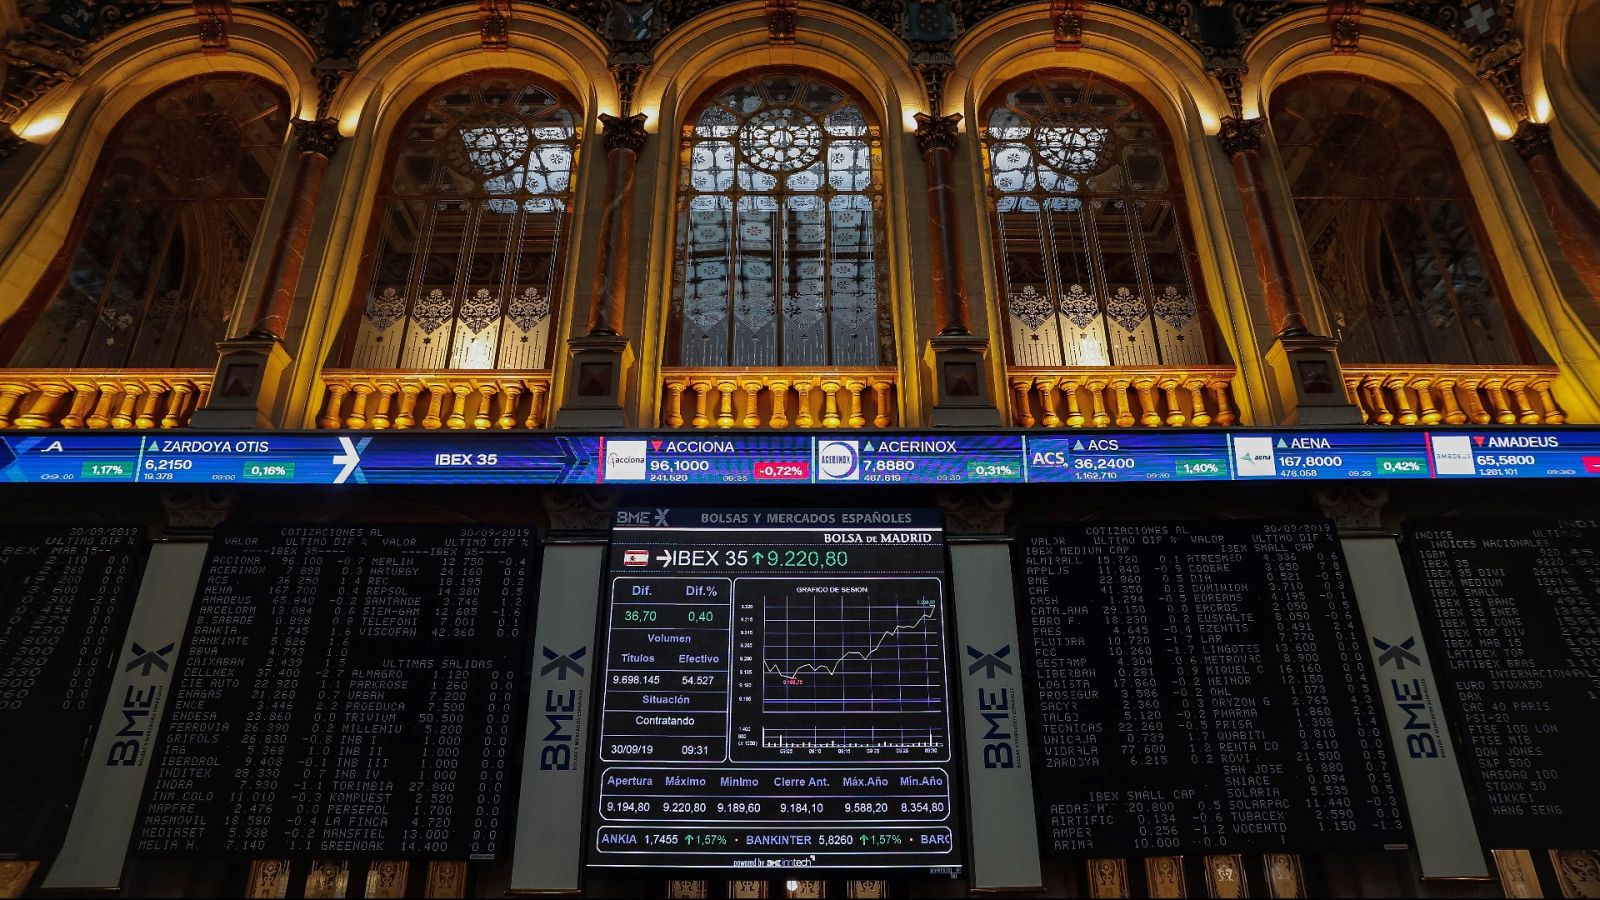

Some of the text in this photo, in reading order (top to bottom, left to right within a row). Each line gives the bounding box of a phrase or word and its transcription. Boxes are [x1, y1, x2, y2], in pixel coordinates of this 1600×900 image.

[162, 441, 269, 452] ZARDOYA OTIS
[666, 441, 735, 452] ACCIONA
[878, 441, 957, 452] ACERINOX
[1088, 440, 1119, 451] ACS
[1290, 438, 1331, 449] AENA
[1488, 436, 1559, 448] AMADEUS
[435, 454, 498, 466] IBEX 35
[615, 456, 645, 464] acciona
[821, 456, 851, 464] ACERINOX
[1032, 453, 1065, 465] ACS
[1074, 458, 1135, 470] 36,2400
[1278, 456, 1342, 468] 167,8000
[1476, 455, 1536, 466] 65,5800
[92, 465, 123, 475] 1,17%
[145, 460, 192, 471] 6,2150
[650, 460, 709, 472] 96,1000
[863, 460, 914, 472] 7,8880
[1184, 464, 1218, 474] 1,40%
[1384, 462, 1420, 472] 0,42%
[251, 466, 285, 476] 0,16%
[759, 466, 803, 477] -0,72%
[976, 466, 1012, 476] 0,31%
[616, 512, 650, 524] BME
[701, 512, 912, 524] BOLSAS Y MERCADOS ESPAÑOLES
[281, 528, 530, 537] COTIZACIONES AL 30/09/2019
[1086, 524, 1330, 535] COTIZACIONES 30/09/2019
[225, 537, 514, 546] VALOR ULTIMO DIF VALOR ULTIMO DIF
[824, 533, 863, 544] BOLSA
[880, 533, 932, 544] MADRID
[1060, 546, 1130, 555] MEDIUM CAP
[212, 556, 260, 565] ACCIONA
[372, 558, 414, 566] MERLIN
[672, 550, 849, 570] IBEX 35 9.220,80
[370, 568, 483, 576] NATURGY 24.160
[1028, 576, 1141, 585] BME 22.860
[205, 586, 232, 595] AENA
[366, 587, 480, 596] REPSOL 14.380
[632, 585, 718, 597] Dif. Dif.%
[1192, 584, 1248, 592] DOMINION
[200, 606, 257, 615] ARCELORM
[363, 608, 420, 616] SIEM-GAM
[362, 618, 418, 626] TELEFONI
[624, 610, 714, 624] 36,70 0,40
[194, 626, 238, 634] BANKIA
[360, 628, 475, 637] VISCOFAN 42.360
[192, 636, 249, 645] BANKINTE
[648, 634, 692, 644] Volumen
[186, 658, 244, 666] CAIXABAN
[621, 653, 720, 664] Títulos Efectivo
[382, 660, 494, 669] ULTIMAS SALIDAS
[350, 680, 408, 690] PARKROSE
[612, 675, 714, 686] 9.698.145 54.527
[1456, 682, 1486, 690] EURO
[642, 694, 690, 706] Situación
[346, 702, 465, 712] PROEDUCA 7.500
[172, 712, 292, 721] ENDESA 23.860
[635, 716, 696, 727] Contratando
[1391, 678, 1438, 758] BME
[106, 685, 156, 766] BME
[170, 723, 230, 732] FERROVIA
[540, 690, 576, 770] BME
[978, 688, 1014, 768] BME
[1043, 722, 1163, 732] TECNICAS 22.260
[611, 744, 710, 756] 30/09/19 09:31
[159, 768, 212, 778] INDITEX
[1482, 770, 1528, 780] NASDAQ
[332, 782, 394, 790] TORIMBIA
[607, 776, 654, 788] Apertura
[665, 775, 707, 788] Máximo
[774, 776, 806, 788] Cierre
[808, 776, 830, 788] Ant.
[842, 775, 889, 788] Máx.Año
[1226, 788, 1280, 798] SOLARIA
[1488, 794, 1534, 803] NIKKEI
[606, 802, 944, 815] 9.194,80 9.220,80 9.189,60 9.184,10 9.588,20 8.354,80
[146, 816, 208, 825] MASMOVIL
[1231, 811, 1285, 821] TUBACEX
[644, 834, 678, 846] 1,7455
[696, 834, 727, 846] 1,57%
[746, 834, 812, 846] BANKINTER
[818, 834, 853, 846] 5,8260
[870, 834, 902, 846] 1,57%
[321, 840, 448, 851] GREENOAK 14.400
